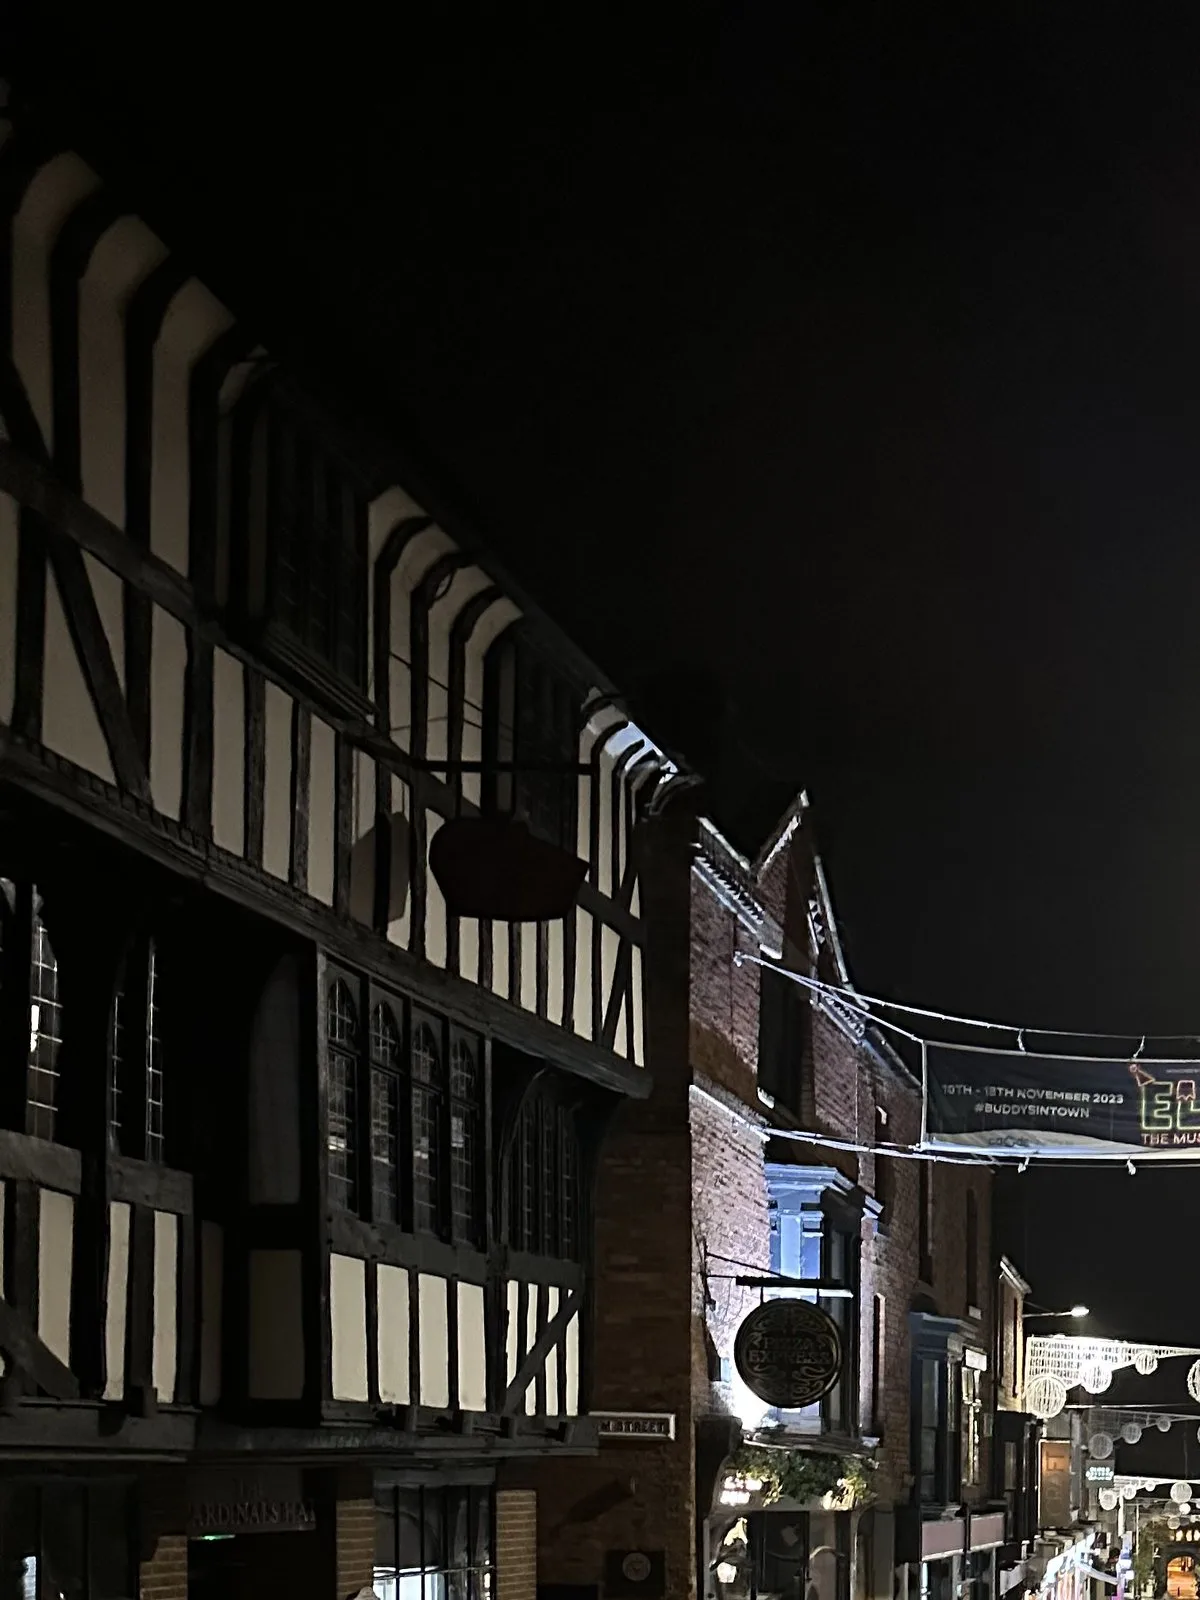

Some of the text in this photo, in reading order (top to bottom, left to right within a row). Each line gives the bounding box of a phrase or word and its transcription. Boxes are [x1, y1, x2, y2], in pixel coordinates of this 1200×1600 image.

[1016, 1088, 1090, 1103] NOVEMBER
[1093, 1093, 1124, 1104] 2023
[975, 1103, 1090, 1118] #BUDDYSINTOWN
[1141, 1133, 1169, 1145] THE
